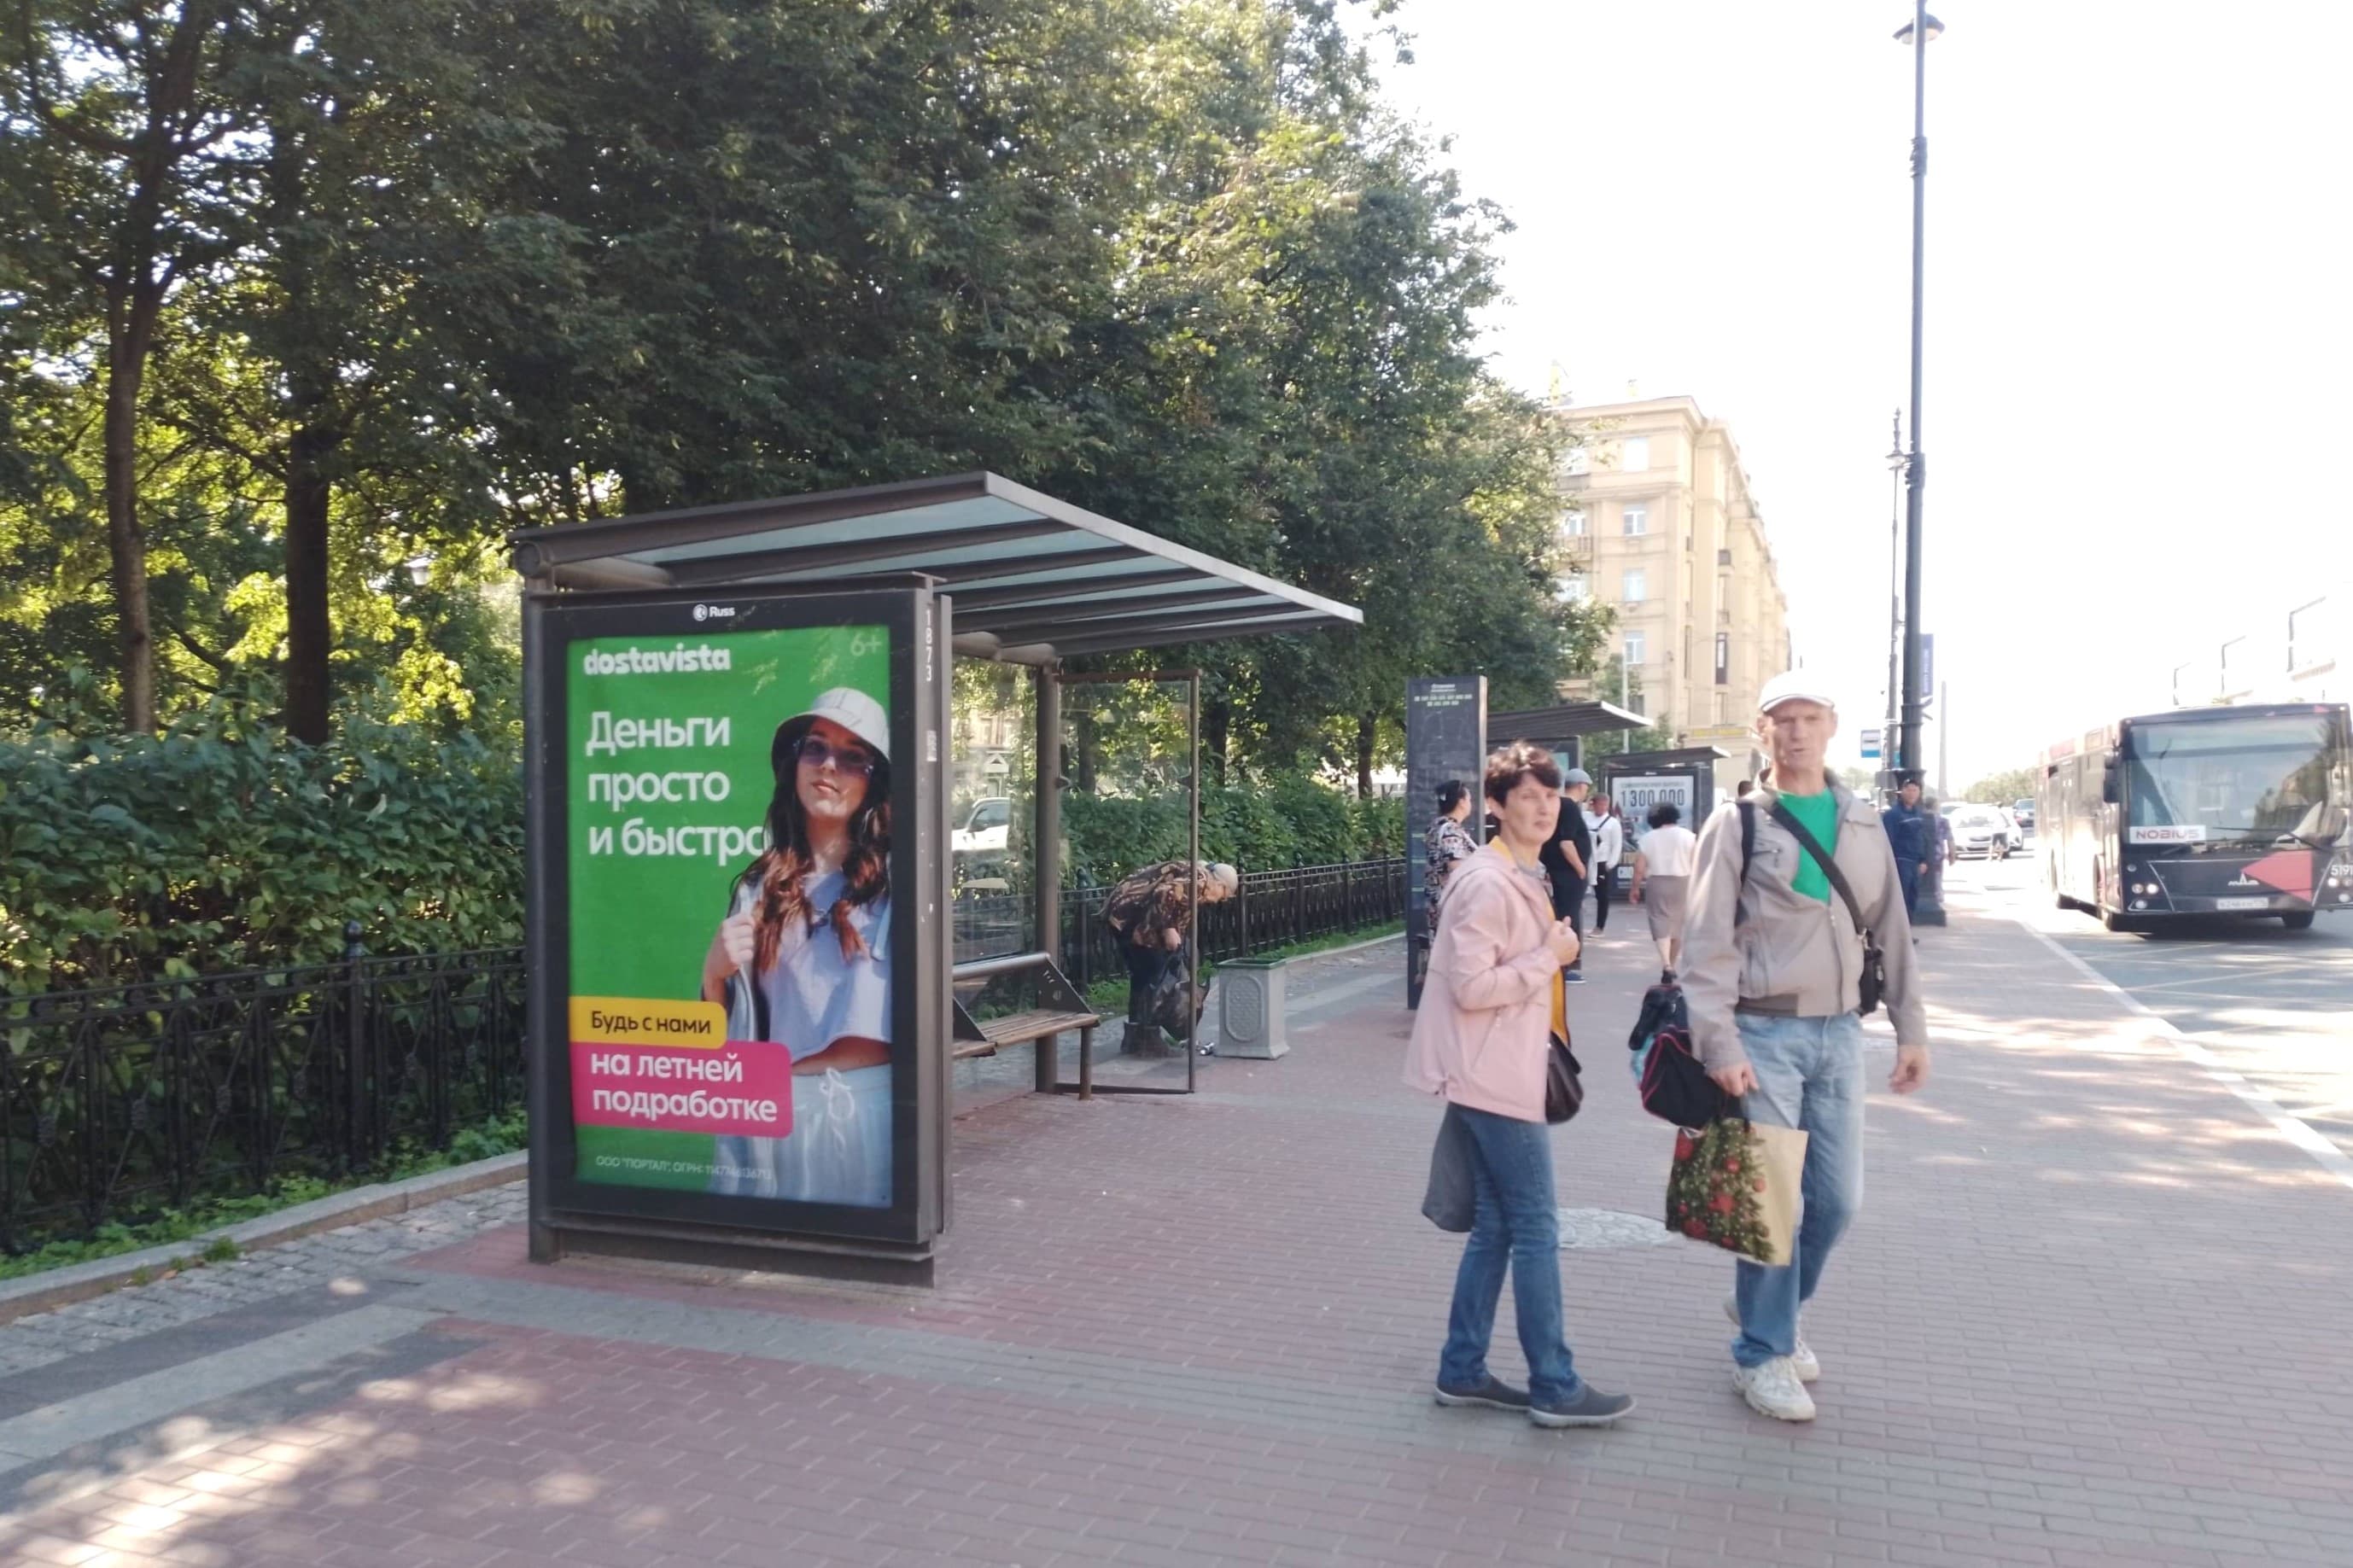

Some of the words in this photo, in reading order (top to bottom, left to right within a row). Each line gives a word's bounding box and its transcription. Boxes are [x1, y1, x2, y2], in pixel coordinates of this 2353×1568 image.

[709, 605, 735, 617] Russ
[583, 642, 732, 675] dostavista
[850, 632, 883, 656] 6+
[925, 609, 933, 682] 1873
[585, 711, 730, 756] Деньги
[587, 771, 731, 812] просто
[588, 826, 613, 855] и
[591, 1011, 639, 1035] Будь
[642, 1016, 652, 1031] с
[657, 1017, 711, 1035] нами
[591, 1052, 631, 1076] на
[636, 1052, 744, 1083] летней
[593, 1089, 778, 1122] подработке
[596, 1156, 621, 1168] ООО
